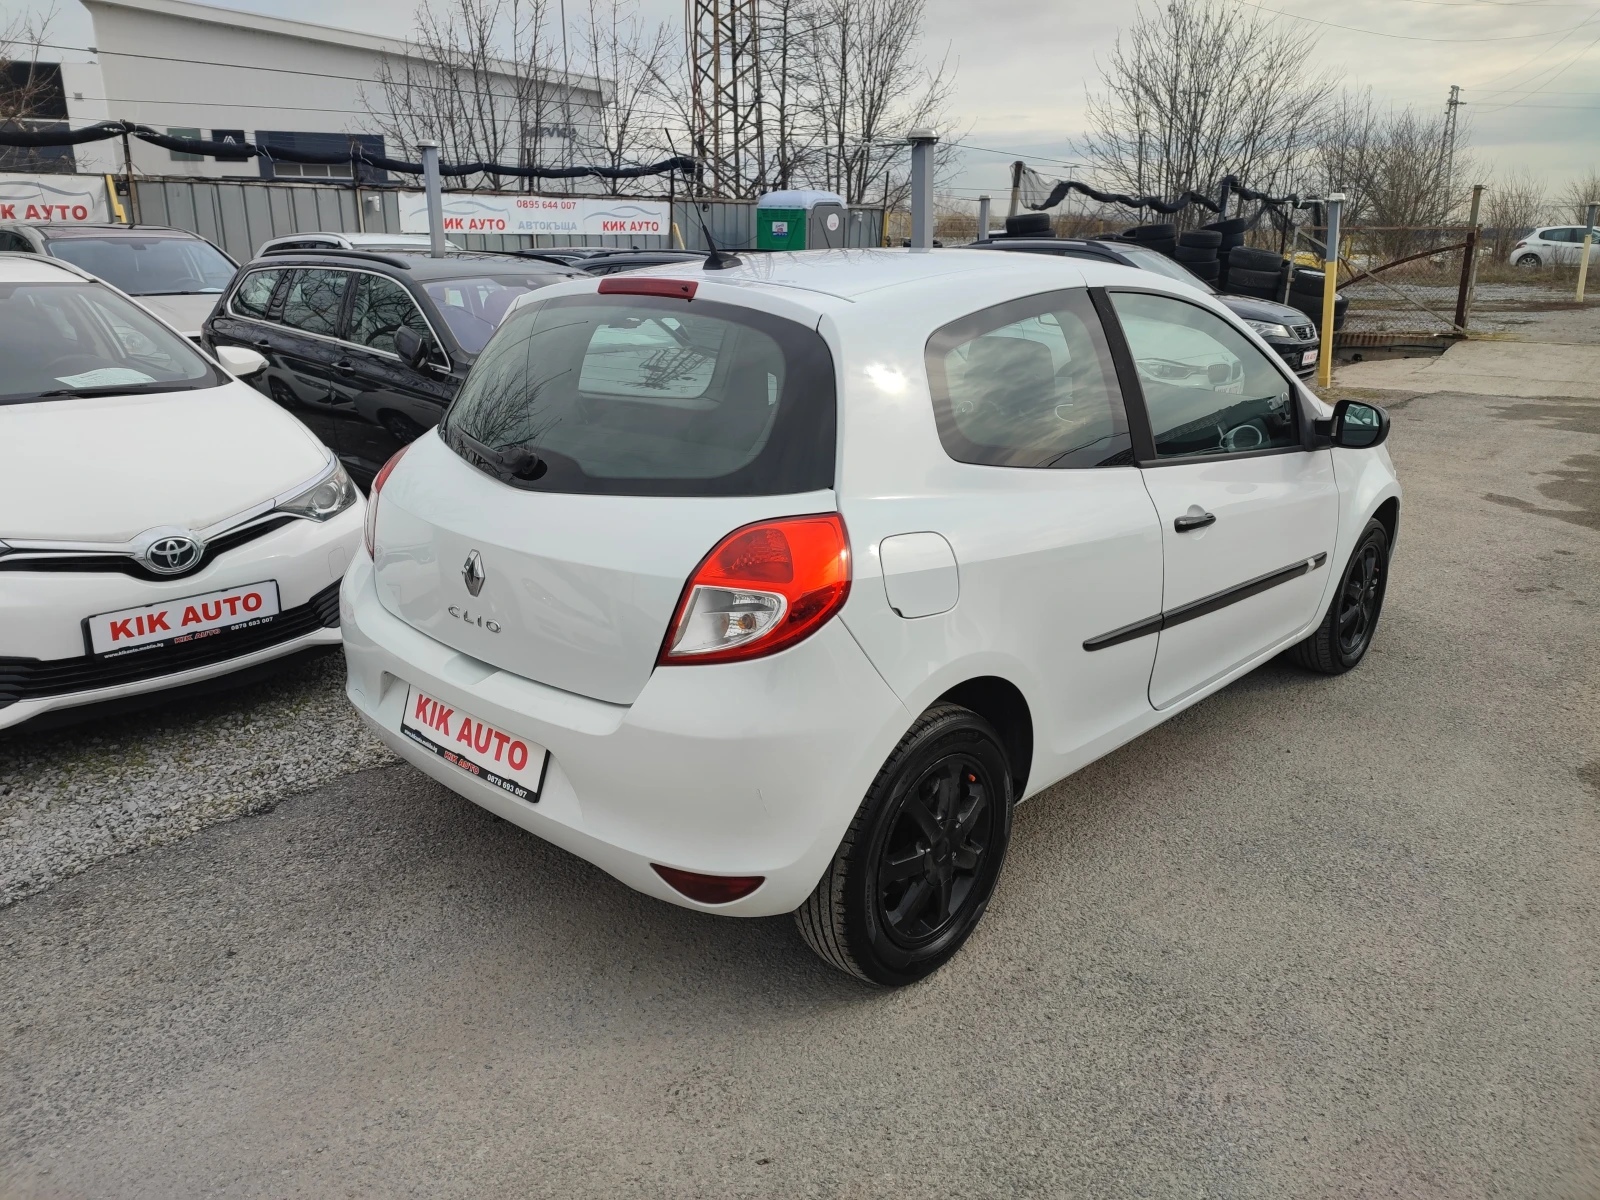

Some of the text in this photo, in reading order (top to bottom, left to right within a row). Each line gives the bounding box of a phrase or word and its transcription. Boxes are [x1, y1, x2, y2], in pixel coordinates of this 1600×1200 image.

[25, 204, 88, 220] АУТО
[516, 200, 577, 210] 0895 644 007
[444, 218, 506, 231] ИК АУТО
[518, 220, 577, 231] АВТОКЪЩА
[602, 221, 659, 232] КИК АУТО
[109, 592, 263, 641] KIK AUTO
[448, 605, 501, 633] CLIO
[174, 634, 193, 644] KIK
[194, 628, 222, 640] AUTO
[261, 616, 274, 624] 007
[415, 693, 528, 771] KIK AUTO
[444, 750, 458, 765] KIK
[458, 759, 480, 775] AUTO
[487, 774, 501, 786] 0878
[502, 782, 514, 792] 693
[514, 788, 527, 798] 007
